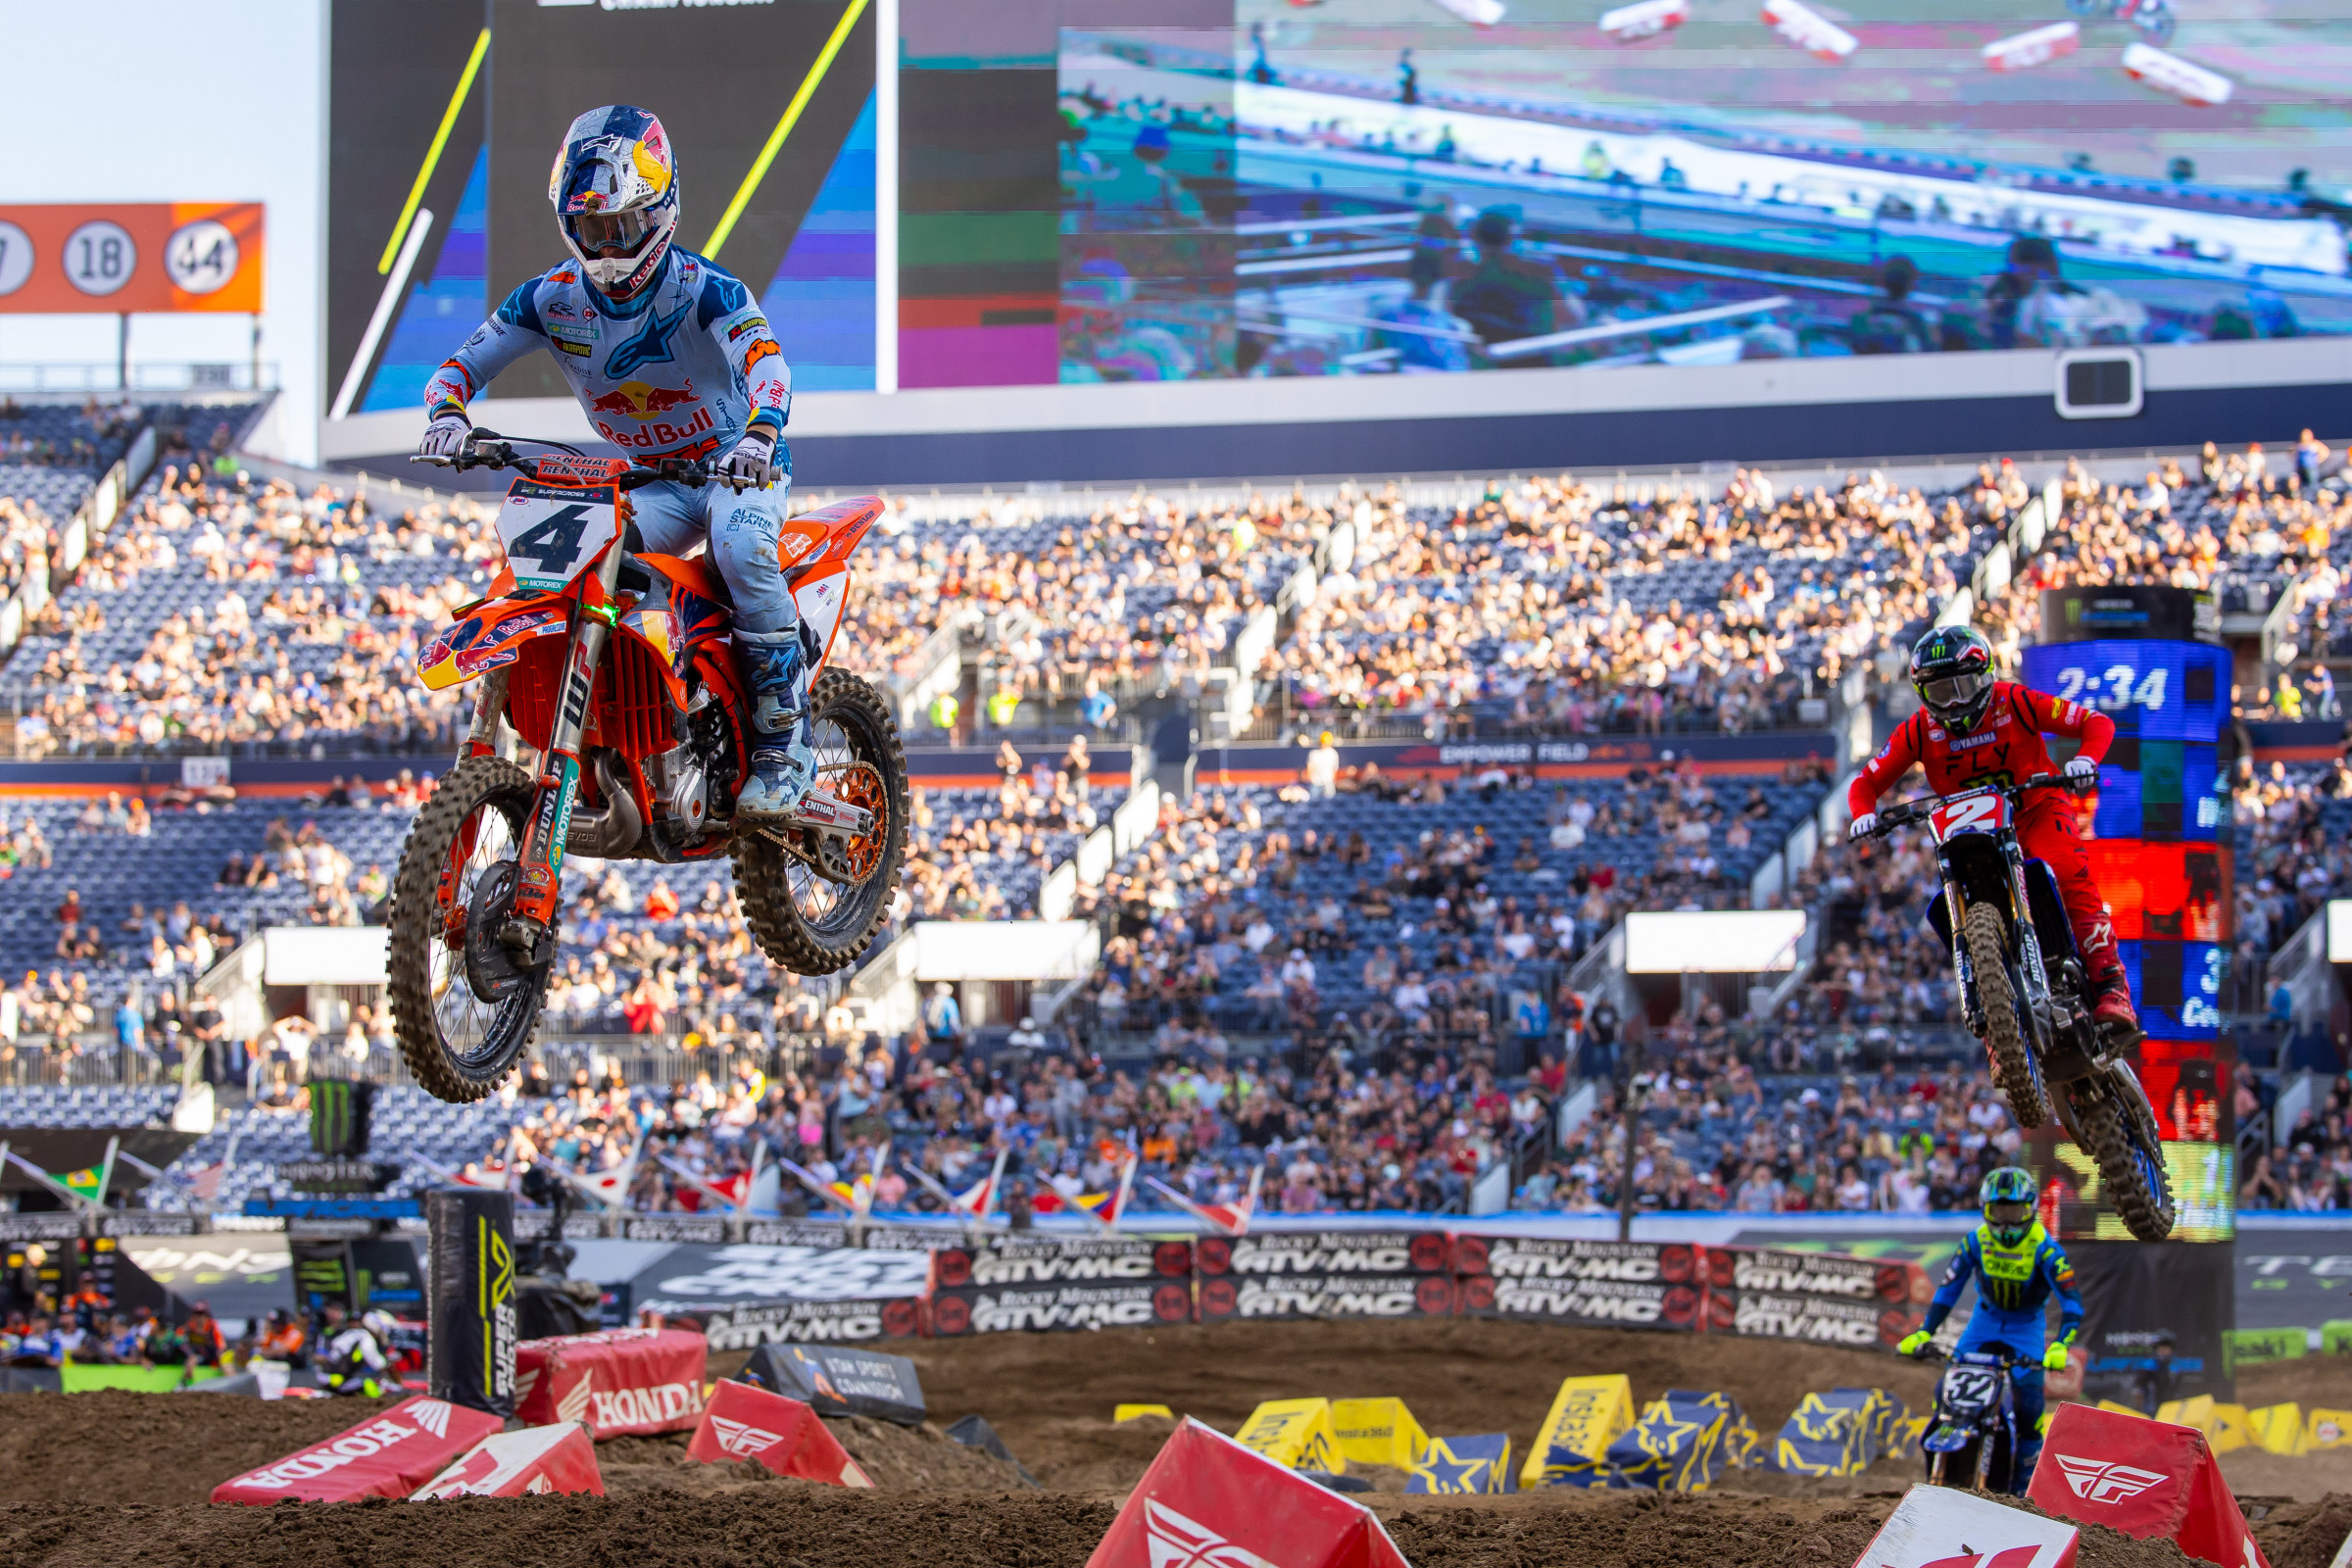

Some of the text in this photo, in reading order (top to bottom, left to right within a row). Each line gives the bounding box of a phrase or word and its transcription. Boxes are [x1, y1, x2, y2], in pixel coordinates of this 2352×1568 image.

[79, 237, 121, 278] 18
[177, 236, 223, 276] 44
[562, 327, 596, 338] MOTOREX
[597, 407, 714, 449] Red Bull
[541, 466, 610, 477] RENTHAL
[508, 505, 595, 574] 4
[730, 515, 768, 531] STARS
[732, 509, 774, 530] ALPINE
[850, 510, 875, 533] DUNLOP
[2057, 664, 2168, 710] 2:34
[1440, 745, 1531, 763] EMPOWER
[1538, 743, 1589, 761] FIELD
[1946, 742, 2010, 775] FLY
[1961, 731, 1996, 749] YAMAHA
[538, 760, 562, 845] DUNLP
[556, 775, 577, 845] MOTOREX
[801, 798, 835, 816] ENTHAL
[1943, 796, 1996, 842] 2
[2025, 934, 2041, 983] DUNLOP
[496, 1302, 509, 1396] SUPER
[592, 1380, 706, 1429] HONDA
[1948, 1371, 1995, 1405] 32
[233, 1419, 418, 1489] HONDA
